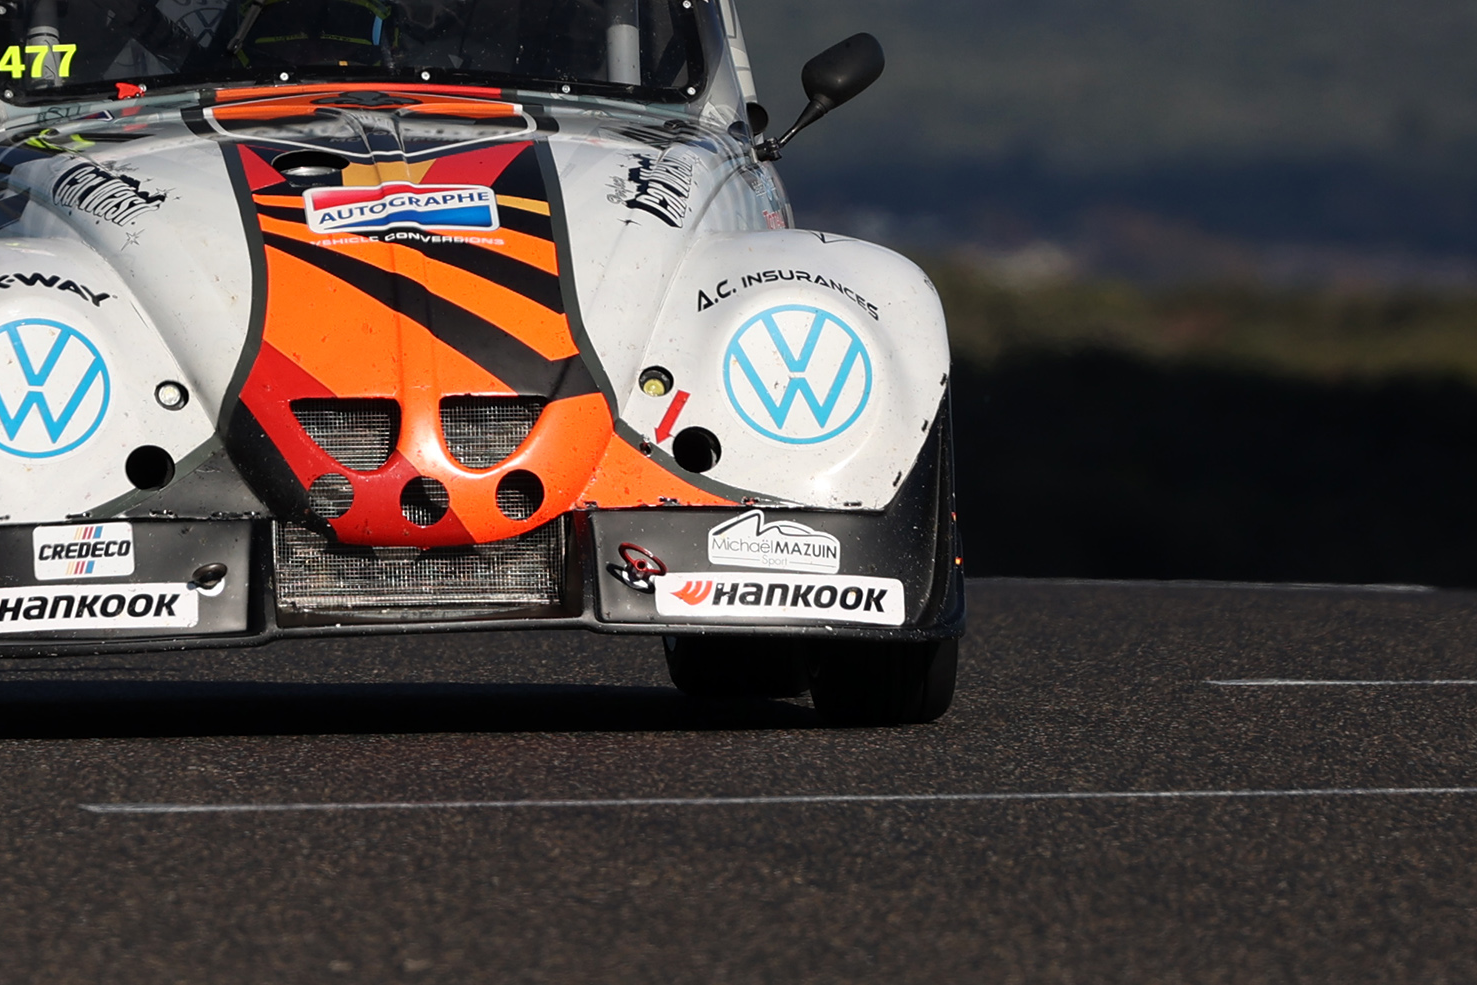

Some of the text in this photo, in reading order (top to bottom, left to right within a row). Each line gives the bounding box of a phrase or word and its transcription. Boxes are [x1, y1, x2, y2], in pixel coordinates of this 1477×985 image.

[317, 191, 490, 225] AUTOGRAPHE
[309, 231, 505, 247] VEHICLE CONVERSIONS
[696, 269, 879, 321] A.C. INSURANCES
[37, 540, 131, 561] CREDECO
[761, 553, 788, 566] Sport
[774, 540, 837, 559] MAZUIN
